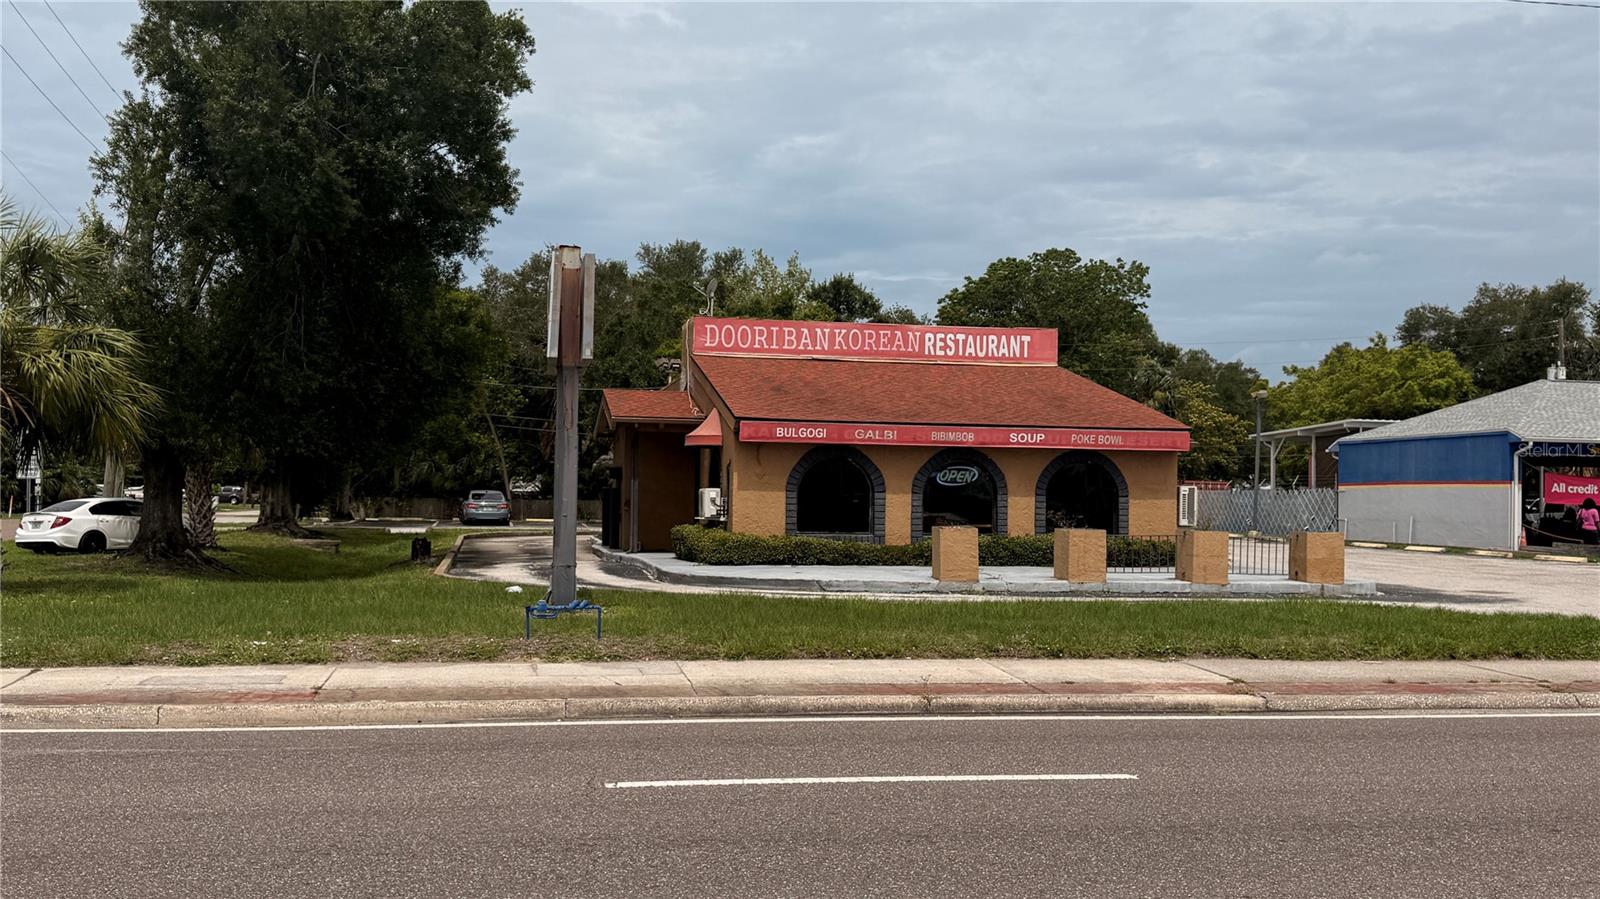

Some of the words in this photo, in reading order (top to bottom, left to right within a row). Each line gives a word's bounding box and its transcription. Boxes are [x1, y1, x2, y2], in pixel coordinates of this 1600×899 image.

[704, 324, 830, 351] DOORIBAN
[833, 329, 921, 352] KOREAN
[924, 332, 1031, 358] RESTAURANT
[776, 427, 827, 438] BULGOGI
[855, 429, 897, 440] GALBI
[931, 431, 975, 442] BIBIMBOB
[1009, 432, 1046, 444] SOUP
[1071, 434, 1096, 445] POKE
[1098, 435, 1124, 446] BOWL
[940, 469, 975, 483] OPEN
[1551, 483, 1566, 493] All
[1567, 484, 1599, 495] credit
